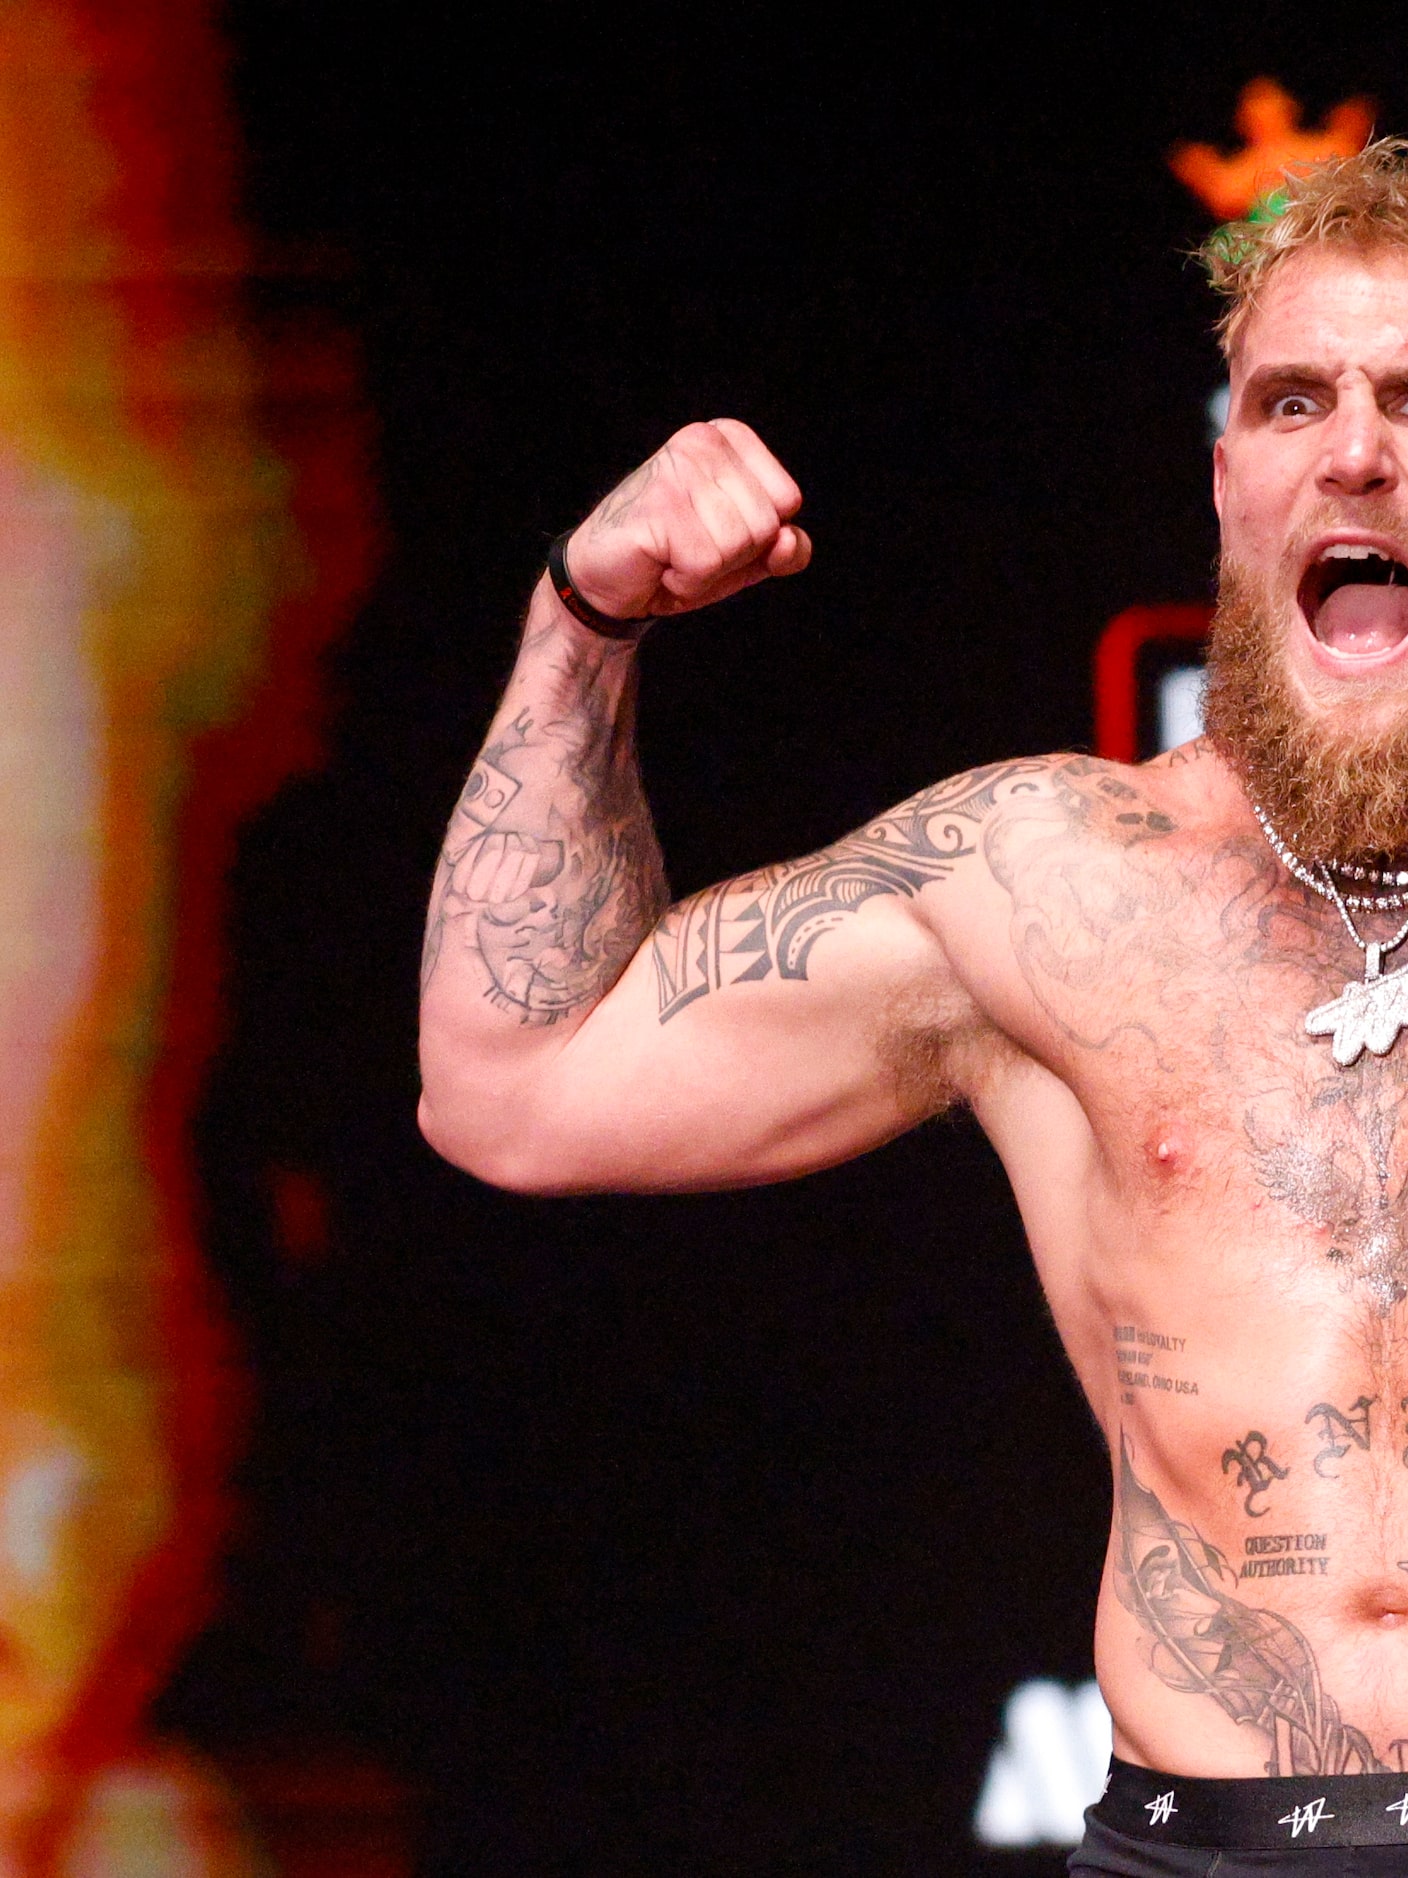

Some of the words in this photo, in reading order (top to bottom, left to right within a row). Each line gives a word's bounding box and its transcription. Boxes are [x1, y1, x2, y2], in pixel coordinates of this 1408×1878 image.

[1175, 1379, 1199, 1396] USA
[1245, 1533, 1327, 1555] QUESTION
[1240, 1557, 1330, 1579] AUTHORITY
